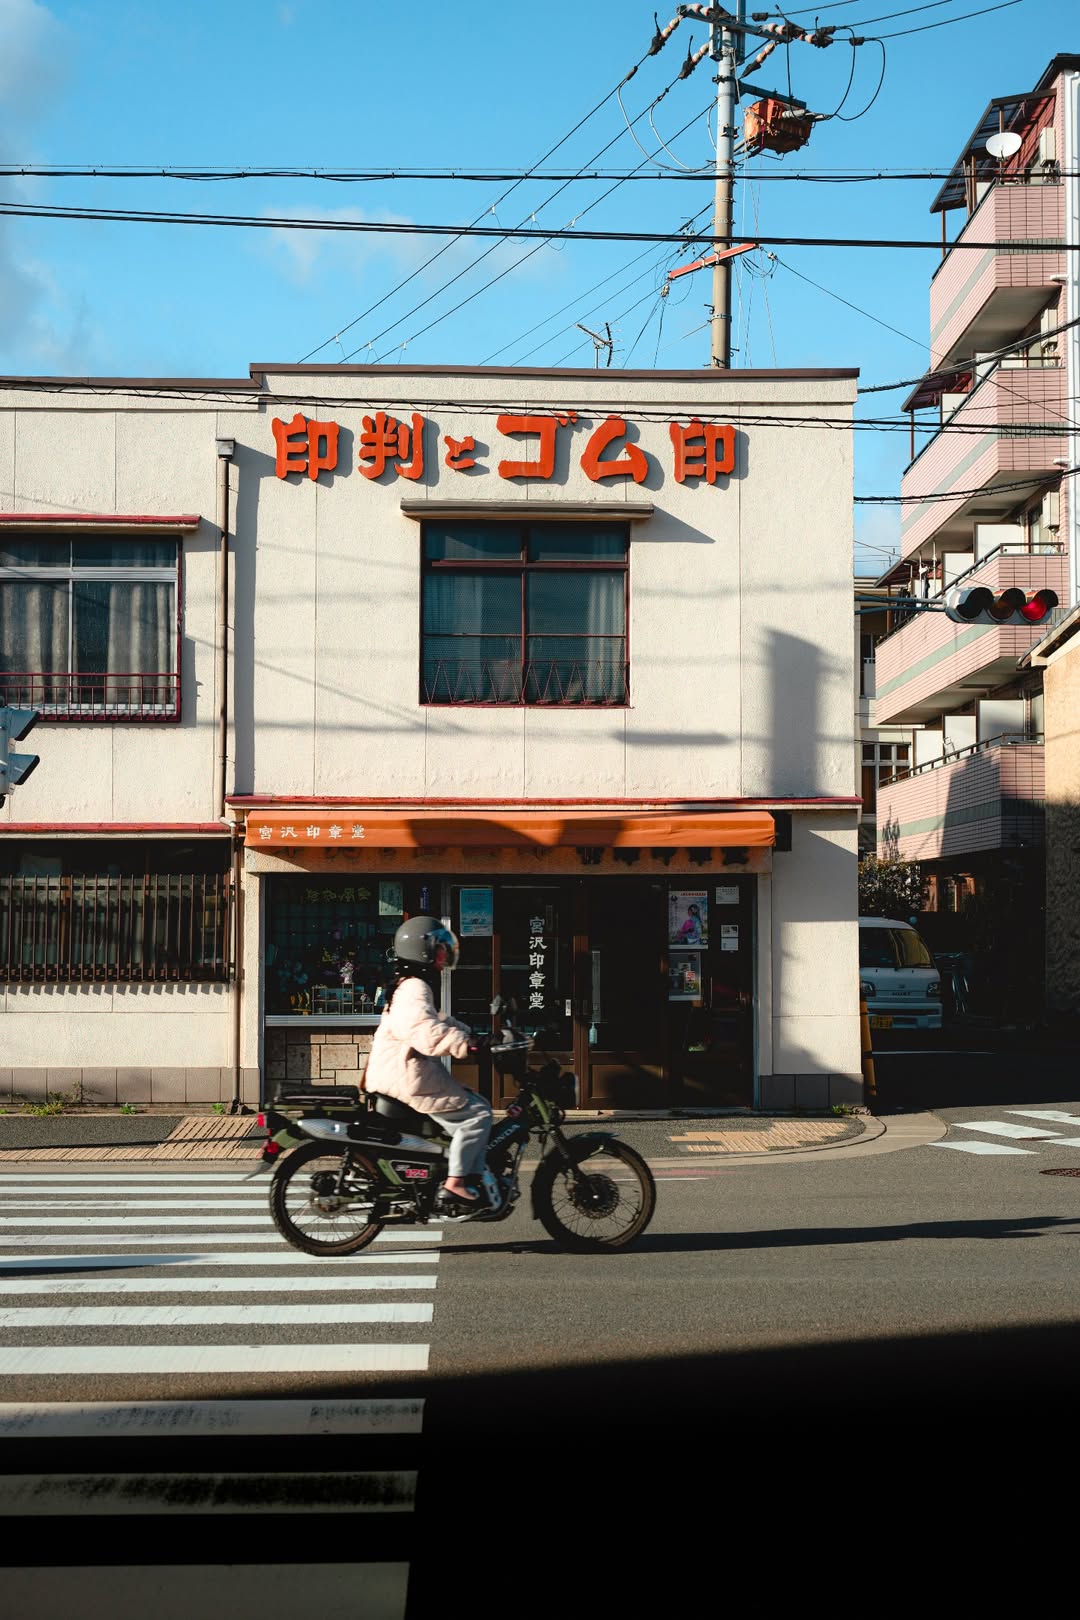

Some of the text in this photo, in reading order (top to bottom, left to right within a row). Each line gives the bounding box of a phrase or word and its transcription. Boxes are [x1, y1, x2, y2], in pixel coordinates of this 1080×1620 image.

[272, 411, 735, 485] 印判とゴム印
[259, 825, 364, 839] 宮沢印章堂
[528, 916, 548, 1010] 宮沢印章堂
[405, 1168, 428, 1178] 125
